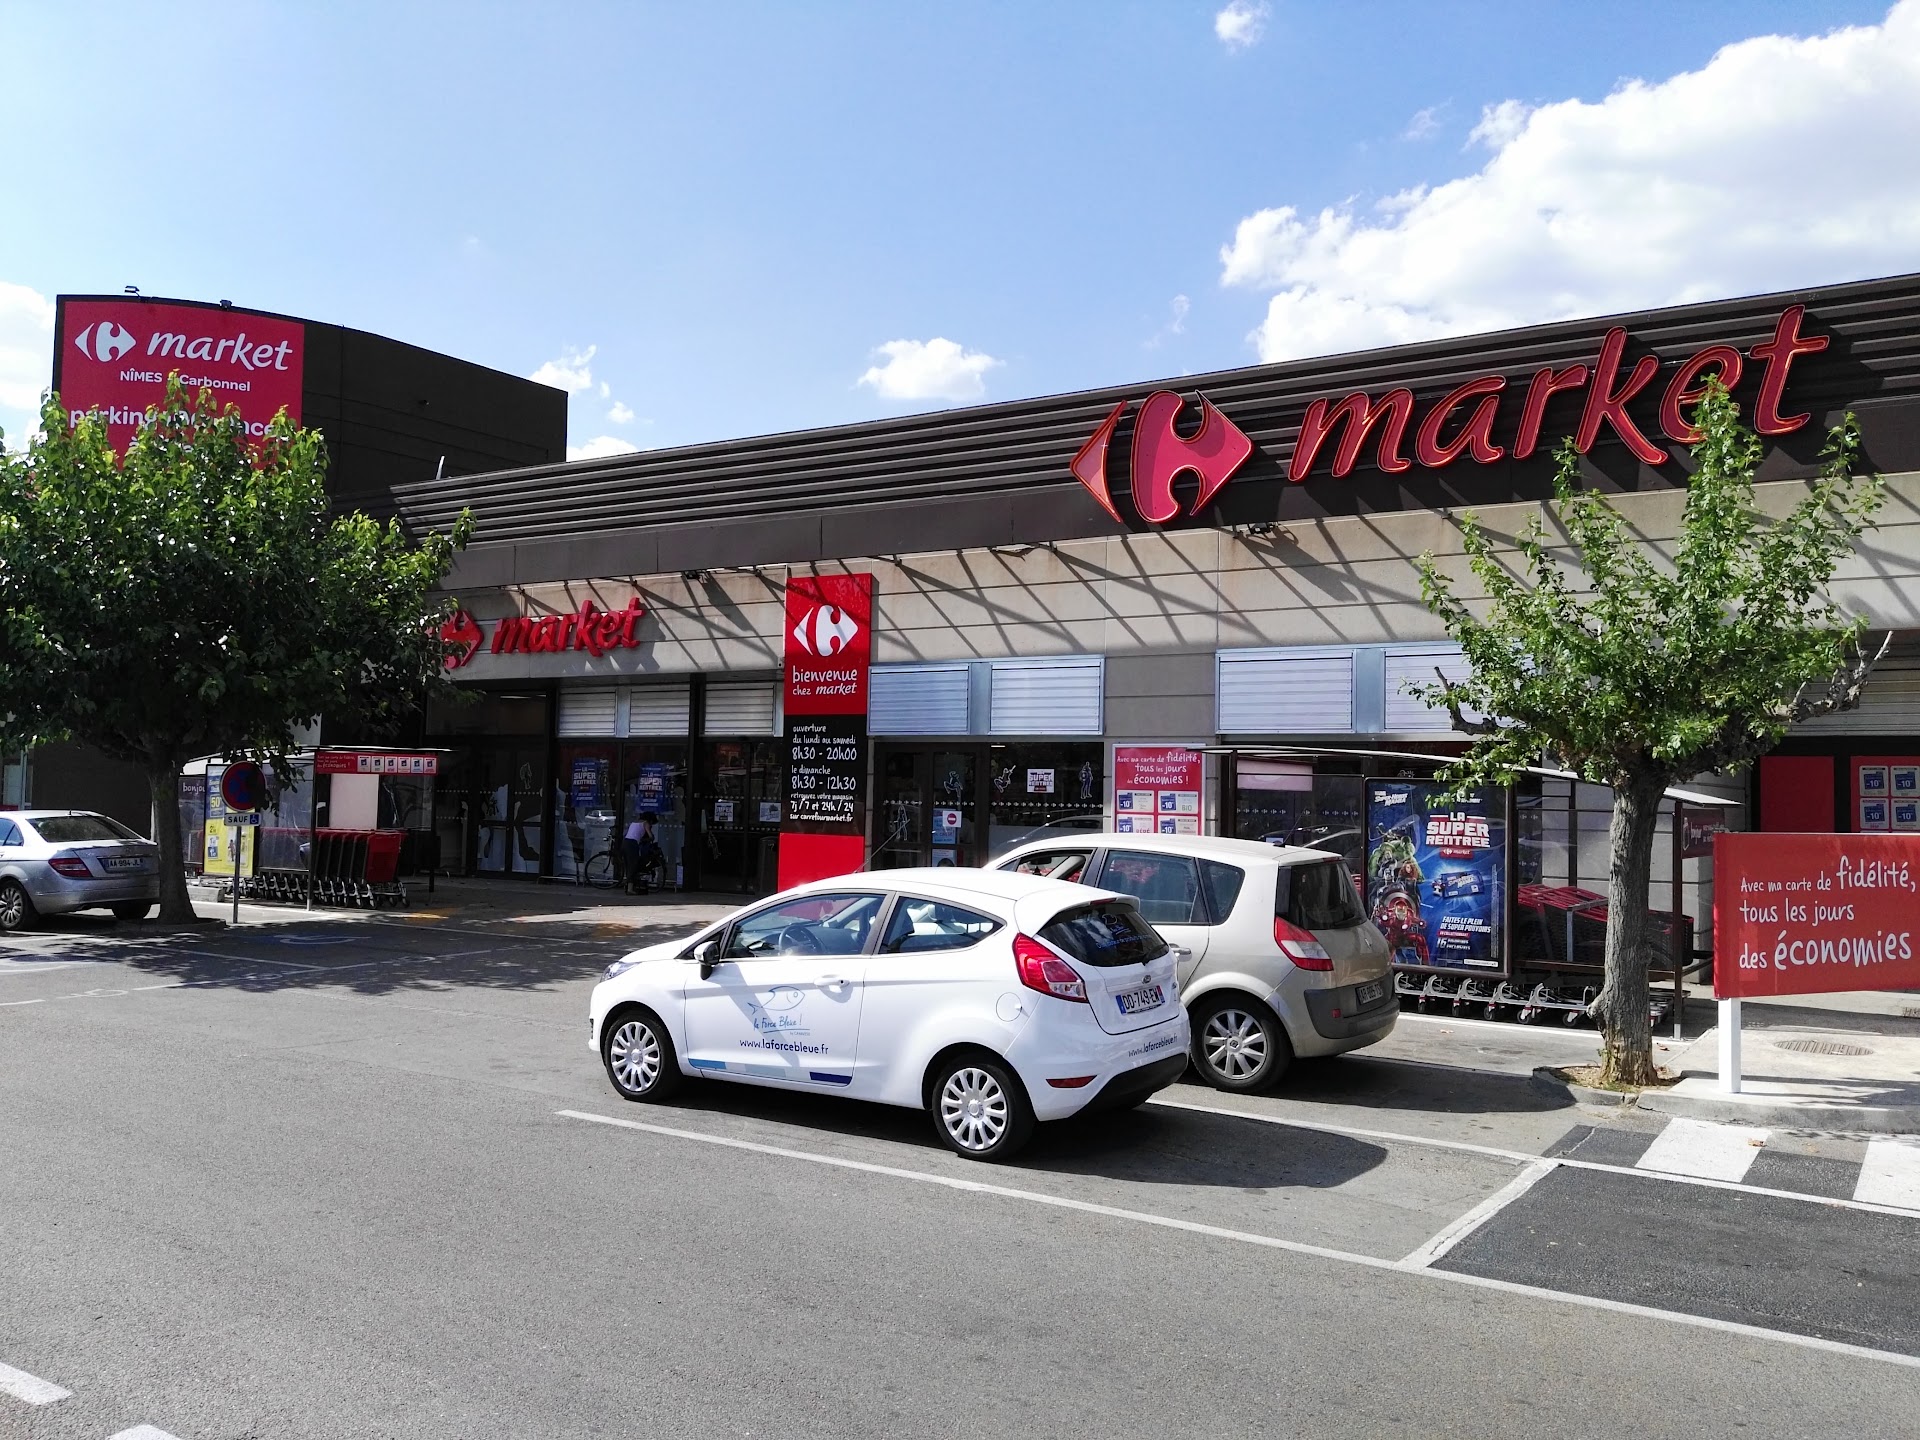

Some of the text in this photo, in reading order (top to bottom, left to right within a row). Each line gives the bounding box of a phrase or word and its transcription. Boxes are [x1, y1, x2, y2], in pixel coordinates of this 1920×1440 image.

[147, 332, 293, 371] market
[120, 367, 251, 391] NÎMES Carbonnel
[1288, 304, 1830, 482] market
[491, 597, 645, 657] market
[793, 665, 858, 684] bienvenue
[793, 682, 857, 695] chez market
[793, 723, 827, 732] ouverture
[793, 734, 802, 744] du
[804, 734, 820, 744] lundi
[833, 734, 856, 744] samedi
[792, 746, 816, 760] 8h30
[826, 746, 857, 760] 20h00
[792, 764, 831, 774] le dimanche
[1135, 763, 1154, 772] tous
[1164, 765, 1187, 774] jours
[573, 772, 596, 780] SUPER
[792, 775, 816, 789] 8h30
[827, 776, 856, 790] 12h30
[1134, 774, 1183, 785] économies
[812, 802, 819, 810] et
[822, 801, 836, 811] 24h
[844, 802, 854, 812] 24
[228, 815, 248, 823] SAUF
[1450, 812, 1466, 821] LA
[1426, 821, 1490, 838] SUPER
[1741, 855, 1916, 892] Avec ma carte de fidélité,
[1739, 898, 1855, 926] tous les jours
[1442, 916, 1460, 924] FAITES
[1739, 930, 1912, 970] des économies
[762, 1017, 777, 1029] Force
[739, 1038, 829, 1055] www.laforcebleue.fr
[1129, 1033, 1178, 1057] www.laforcebleue.fr
